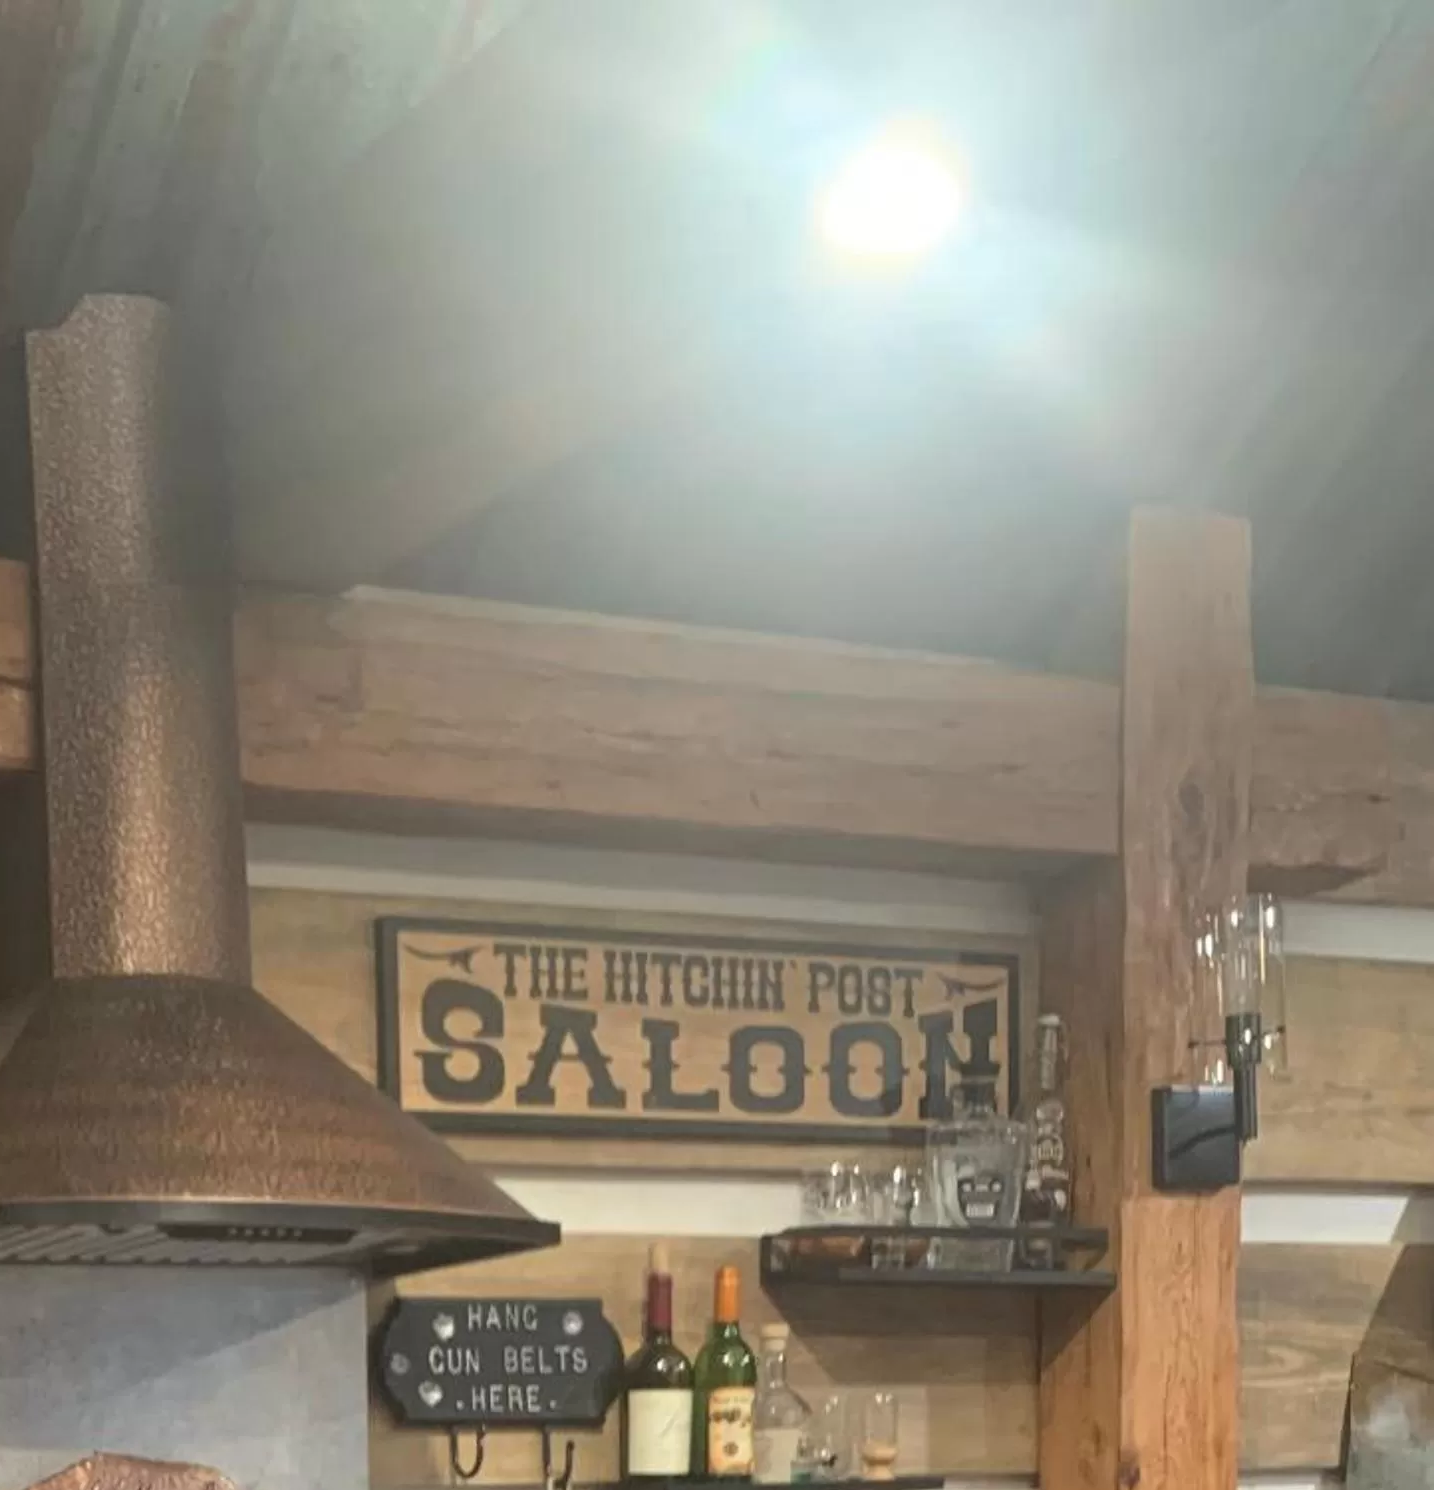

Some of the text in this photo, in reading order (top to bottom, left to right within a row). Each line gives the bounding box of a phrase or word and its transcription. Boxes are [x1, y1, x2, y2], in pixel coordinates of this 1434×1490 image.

[493, 943, 923, 1018] THE HITCHIN' POST
[413, 977, 1002, 1120] SALOON
[468, 1302, 538, 1332] HANG
[428, 1344, 589, 1376] GUN BELTS
[470, 1384, 543, 1414] HERE
